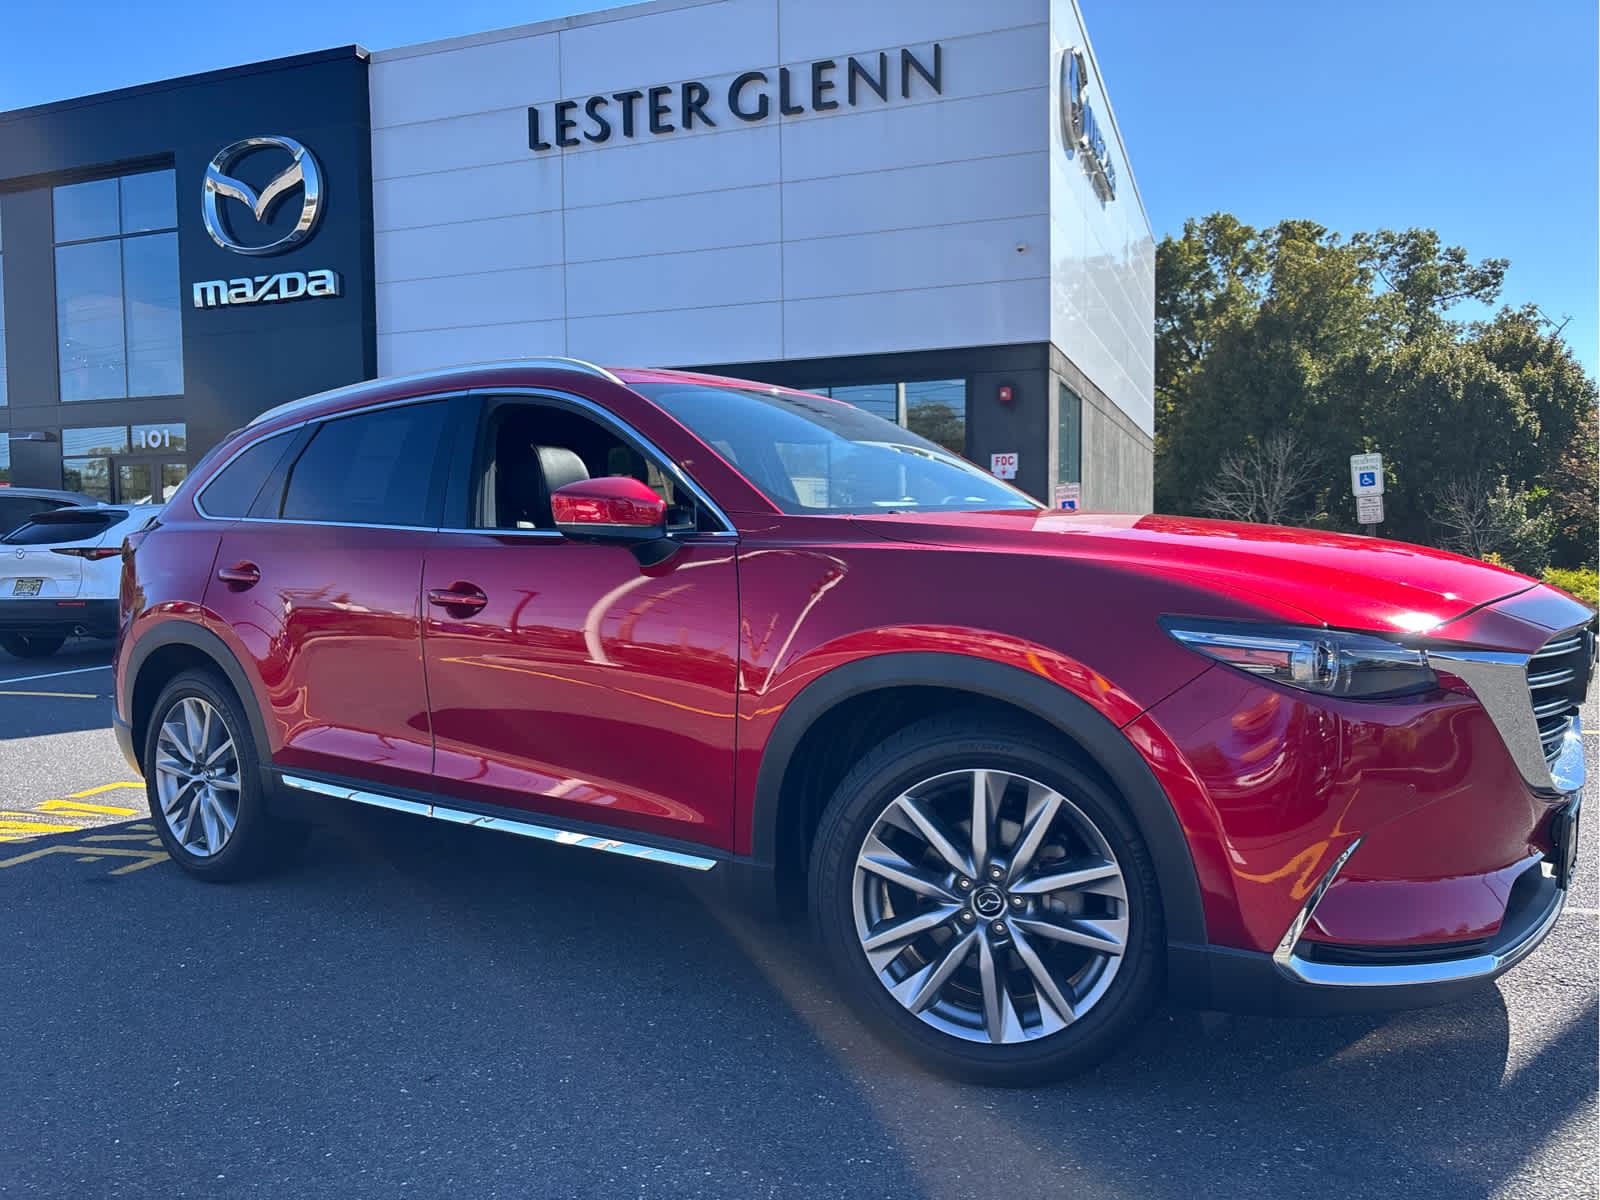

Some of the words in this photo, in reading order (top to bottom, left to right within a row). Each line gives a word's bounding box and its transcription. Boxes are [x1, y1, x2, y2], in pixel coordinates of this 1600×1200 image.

[528, 82, 716, 151] LESTER
[728, 43, 942, 122] GLENN
[140, 429, 169, 449] 101
[994, 455, 1015, 466] FDC
